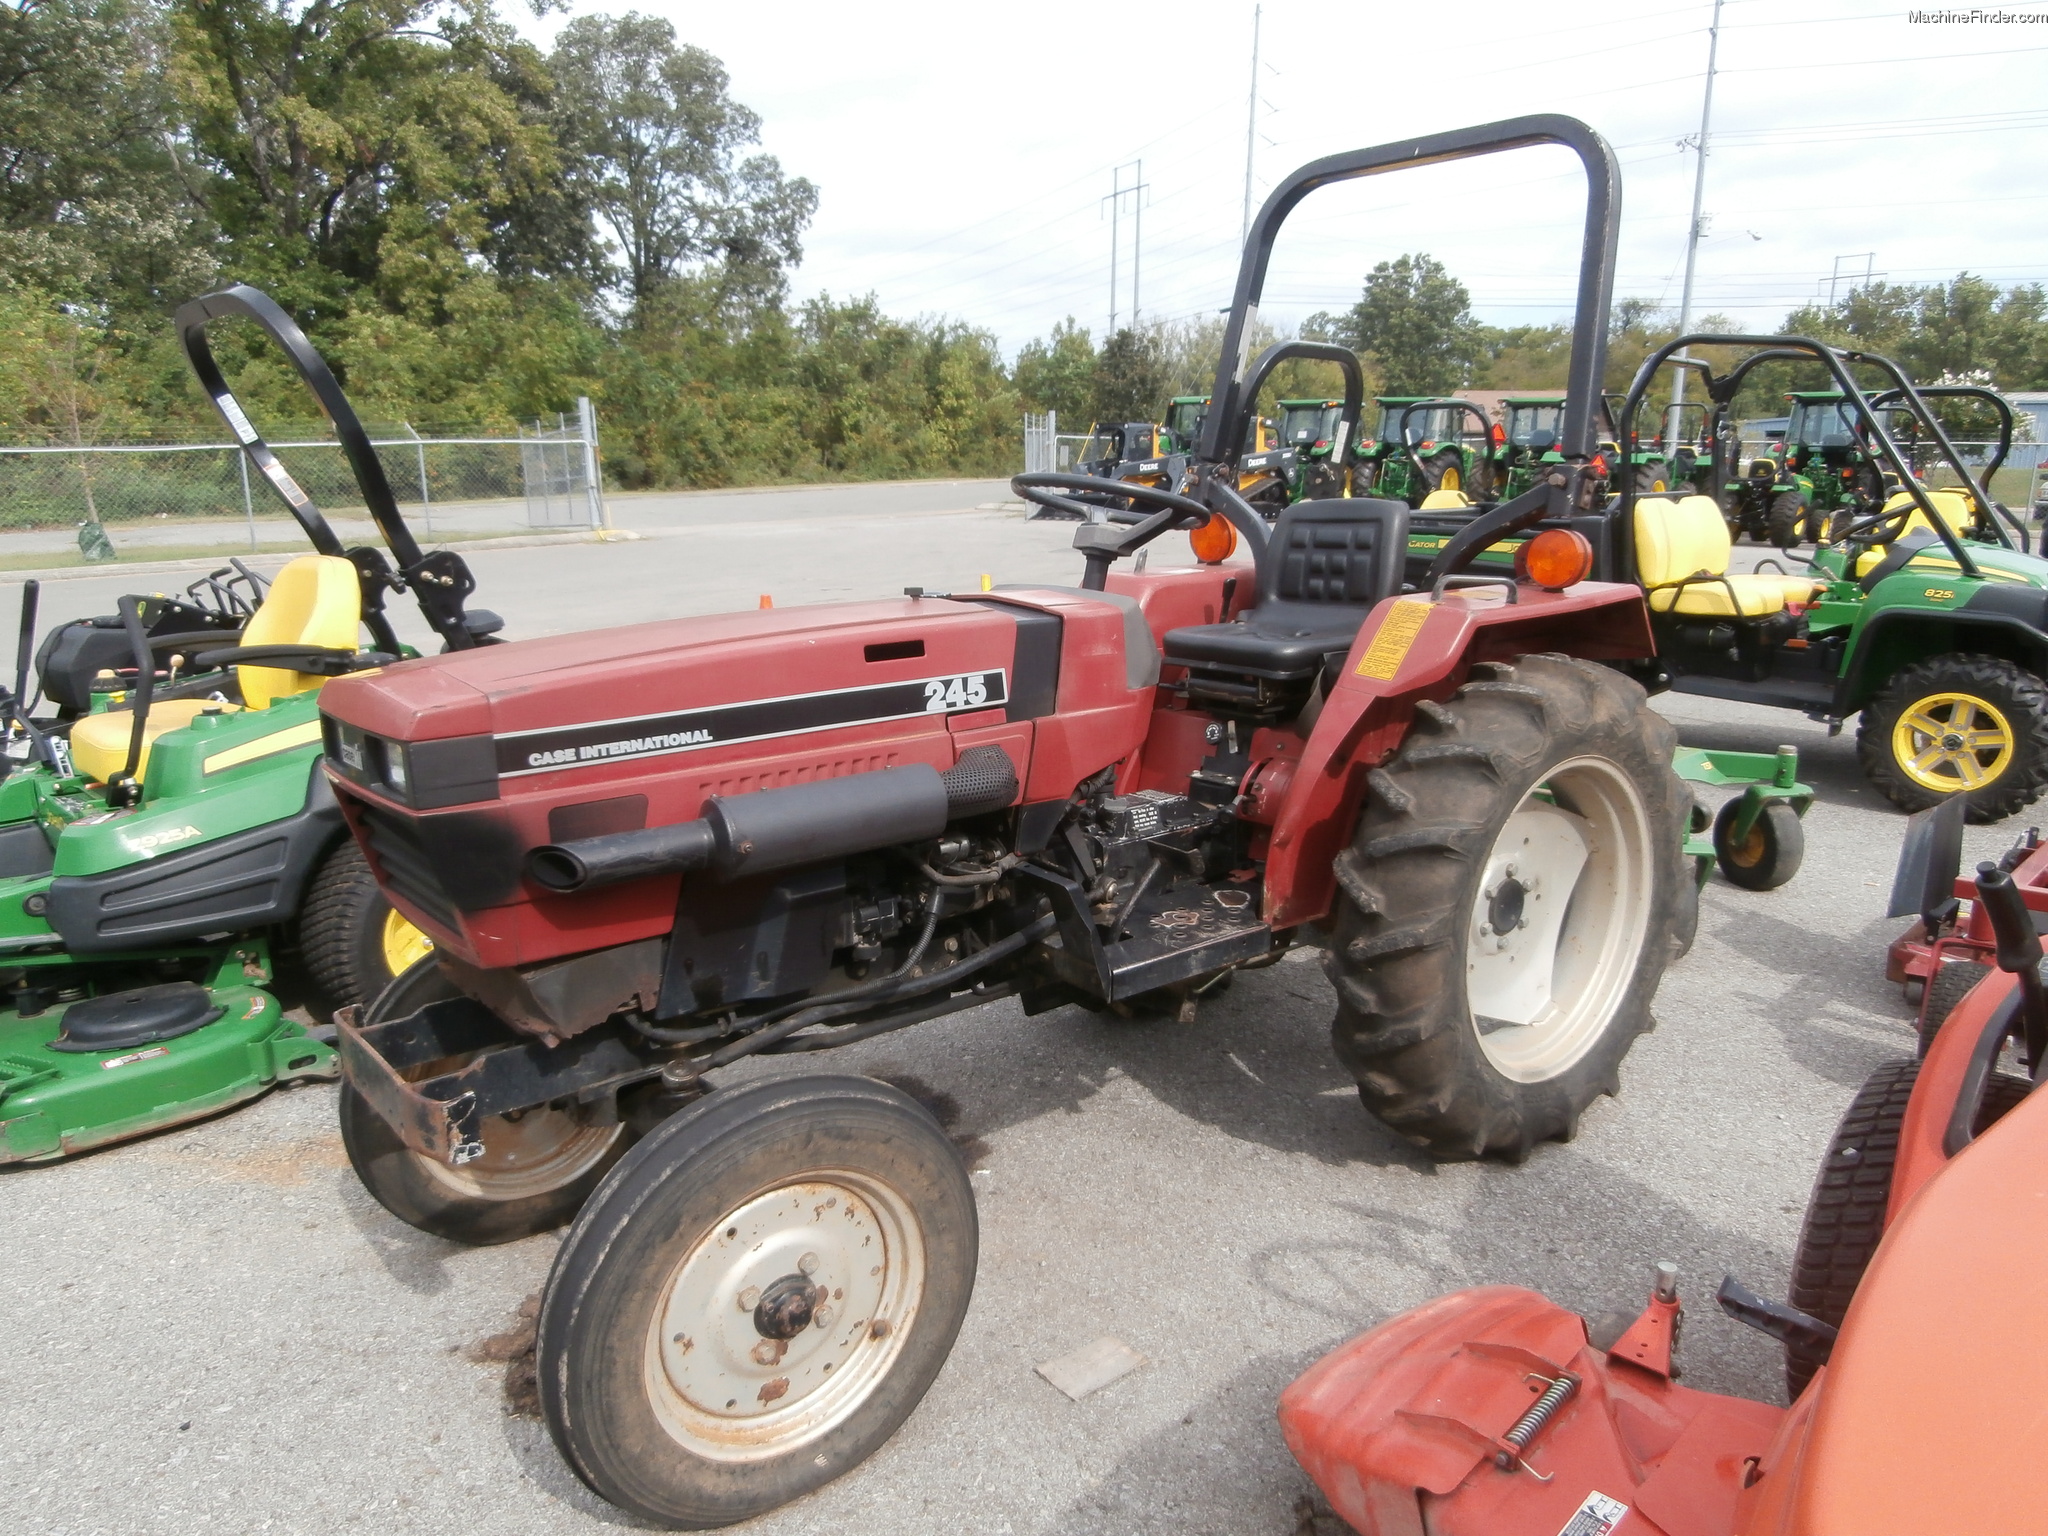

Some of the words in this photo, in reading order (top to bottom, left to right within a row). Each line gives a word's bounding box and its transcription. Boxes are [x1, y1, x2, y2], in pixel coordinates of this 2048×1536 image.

[1408, 540, 1436, 549] GATOR
[923, 675, 987, 711] 245
[528, 748, 577, 766] CASE
[580, 729, 713, 760] INTERNATIONAL
